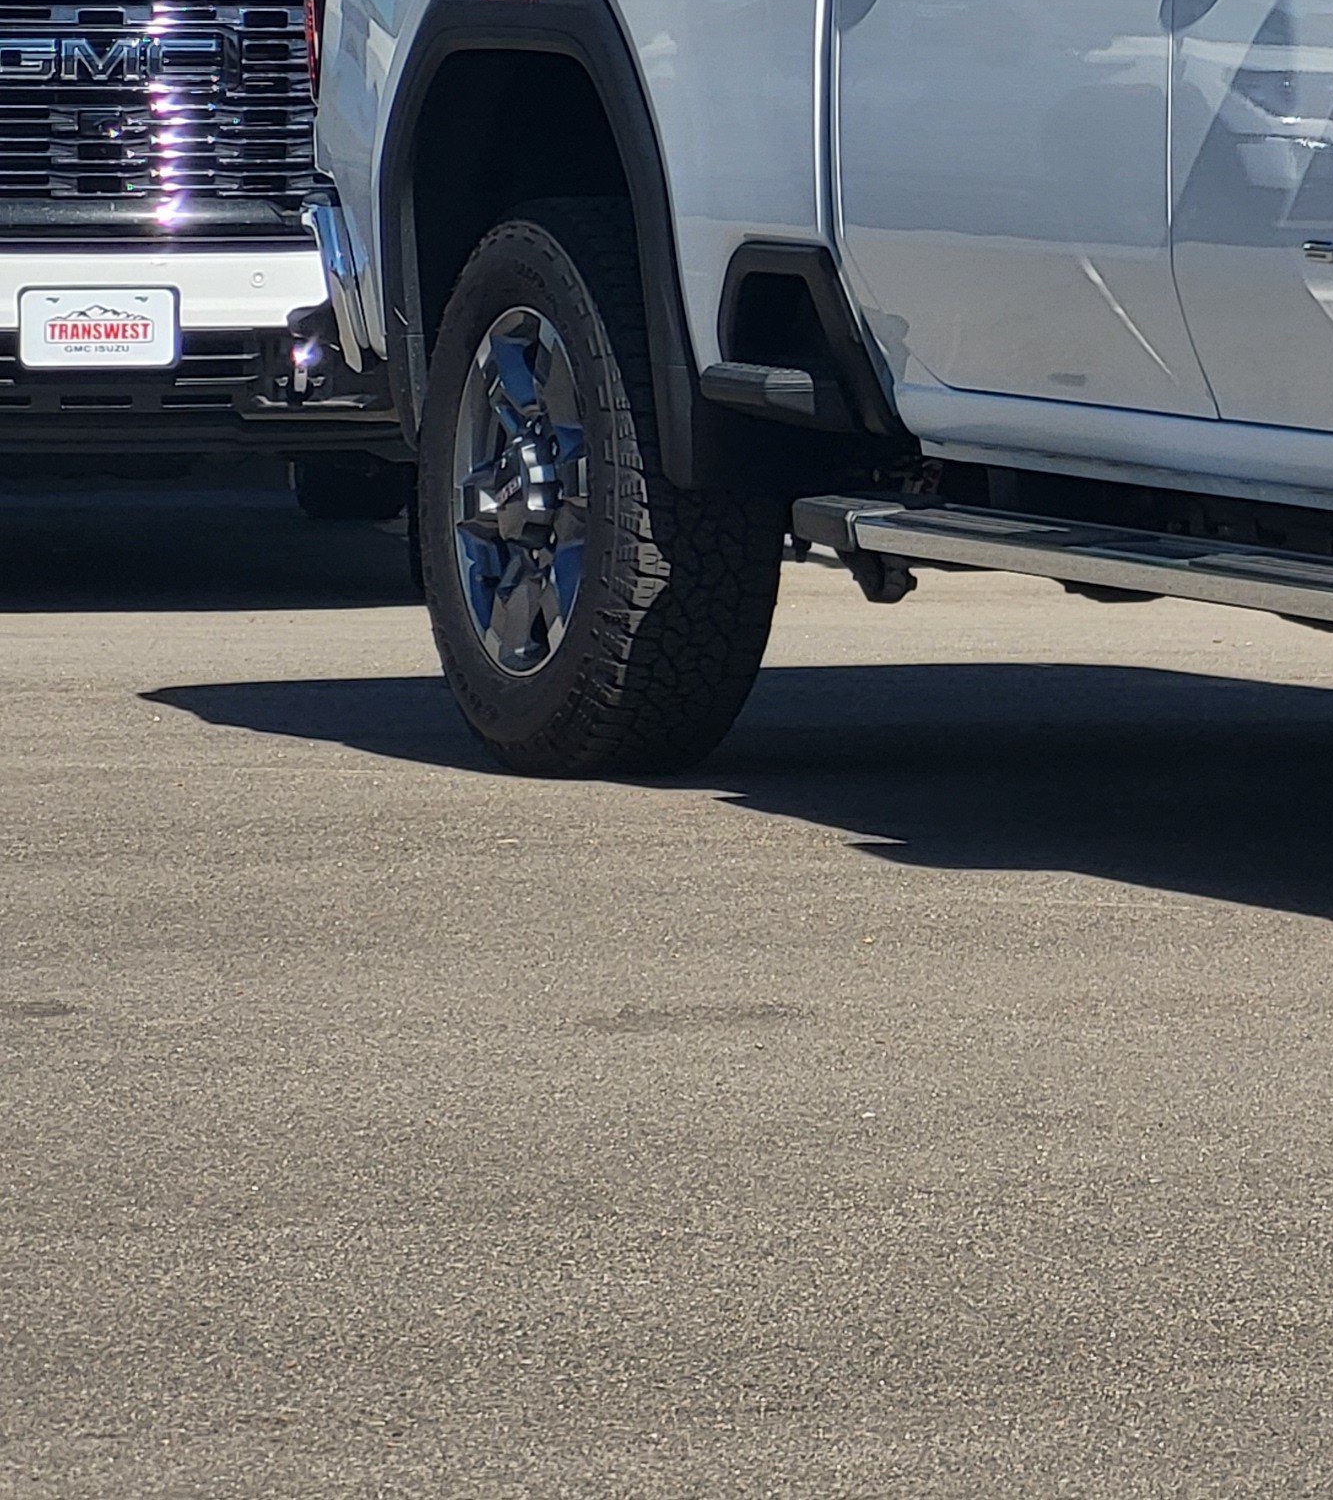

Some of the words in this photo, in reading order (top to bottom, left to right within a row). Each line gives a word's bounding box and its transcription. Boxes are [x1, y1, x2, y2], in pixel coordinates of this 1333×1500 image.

[0, 37, 218, 82] GMC
[48, 322, 151, 340] TRANSWEST
[64, 344, 92, 353] GMC
[95, 345, 130, 353] ISUZU
